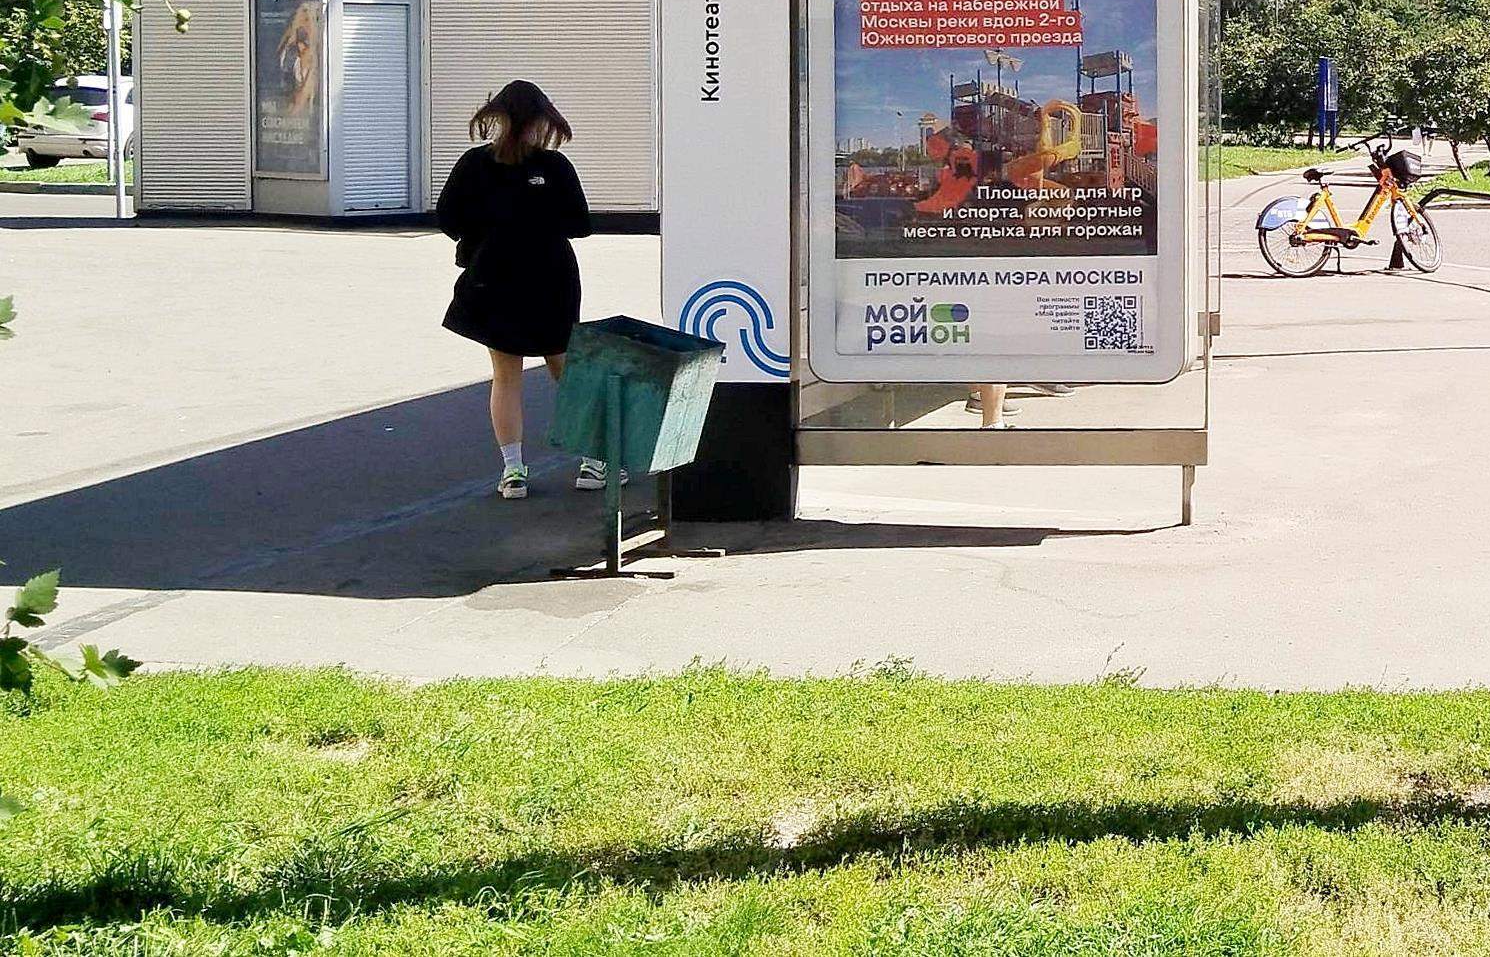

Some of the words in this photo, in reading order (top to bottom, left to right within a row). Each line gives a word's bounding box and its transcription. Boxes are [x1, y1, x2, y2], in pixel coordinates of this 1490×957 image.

[861, 0, 923, 13] отдыха
[928, 1, 948, 11] на
[861, 16, 932, 28] Москвы
[936, 17, 978, 30] реки
[983, 15, 1035, 29] вдоль
[1039, 13, 1076, 26] 2-го
[861, 32, 1005, 47] Южнопортового
[1010, 32, 1083, 46] проезда
[977, 186, 1070, 202] Площадки
[1074, 188, 1108, 201] для
[1112, 188, 1142, 202] игр
[943, 207, 952, 219] и
[957, 207, 1024, 221] спорта,
[1028, 204, 1142, 221] комфортные
[903, 226, 957, 238] места
[961, 226, 1025, 239] отдыха
[1030, 226, 1062, 239] для
[1066, 225, 1143, 239] горожан
[865, 272, 990, 287] ПРОГРАММА
[995, 271, 1051, 286] МЭРА
[1056, 270, 1143, 285] МОСКВЫ
[865, 297, 928, 324] мой
